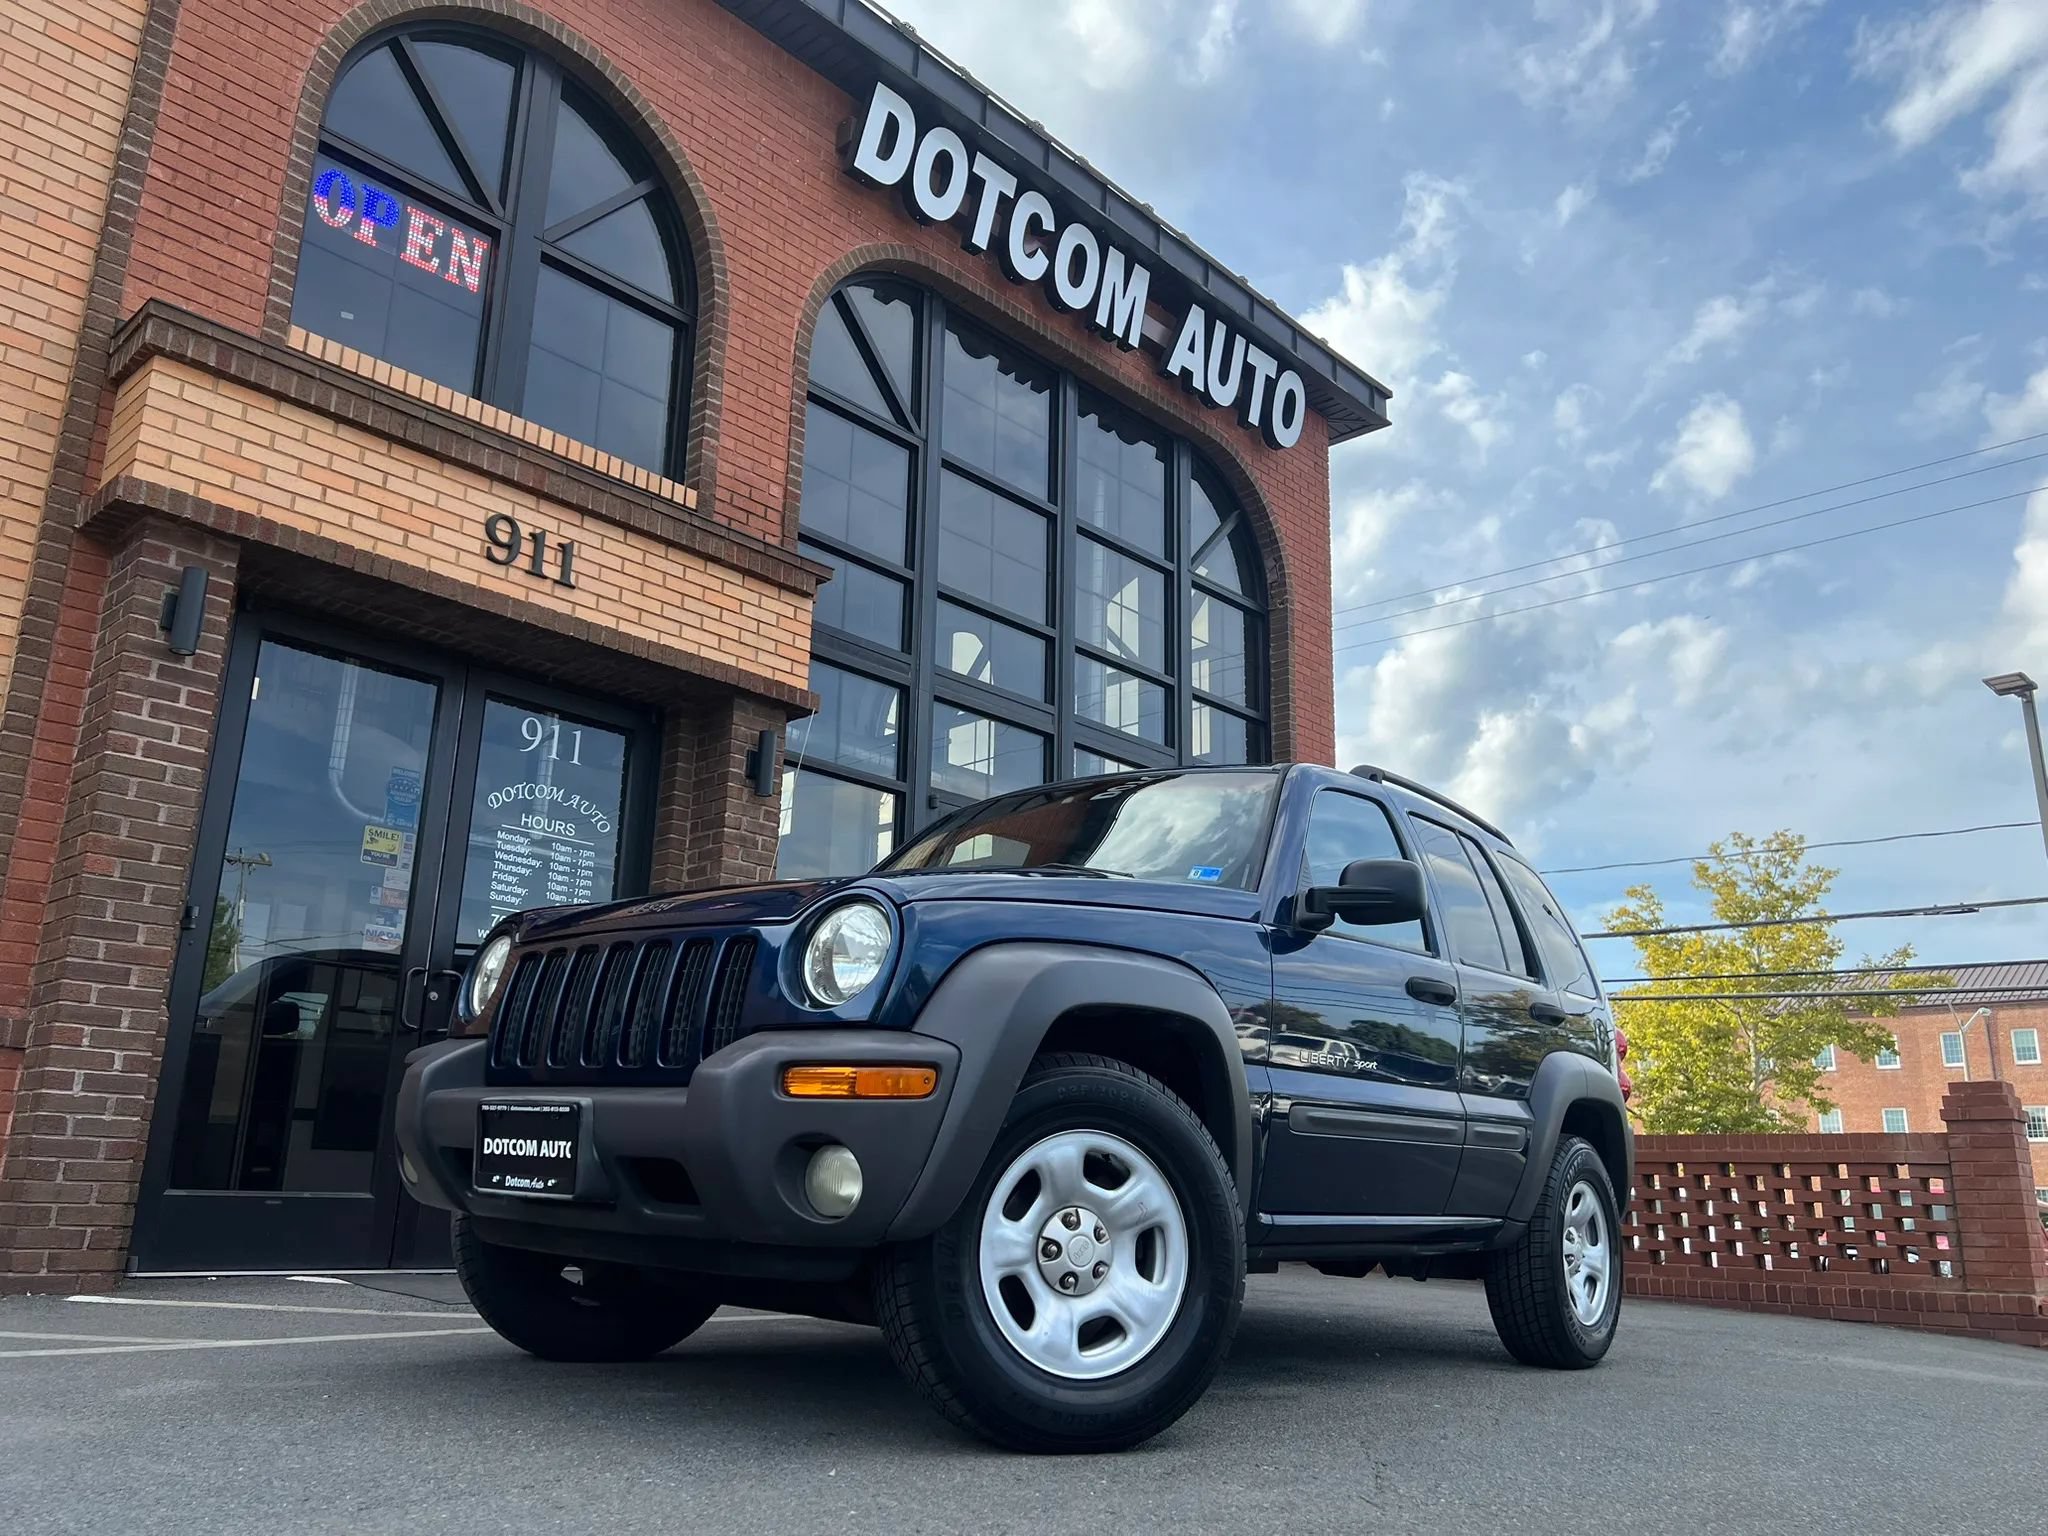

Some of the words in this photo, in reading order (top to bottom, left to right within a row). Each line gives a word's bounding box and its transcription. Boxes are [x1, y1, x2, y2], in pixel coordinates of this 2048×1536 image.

[314, 168, 488, 292] OPEN
[854, 81, 1150, 349] DOTCOM
[1166, 304, 1306, 449] AUTO
[485, 512, 576, 589] 911
[520, 716, 582, 766] 911
[488, 782, 563, 810] DOTCOM
[564, 794, 610, 834] AUTO
[368, 829, 400, 840] SMILE!
[521, 813, 576, 836] HOURS
[497, 831, 531, 844] Monday:
[552, 842, 572, 853] 10am
[579, 849, 595, 857] 7pm
[497, 841, 532, 855] Tuesday:
[551, 852, 571, 862] 10am
[578, 859, 594, 867] 7pm
[494, 861, 532, 875] Thursday:
[548, 872, 569, 882] 10am
[495, 851, 542, 867] Wednesday:
[550, 862, 570, 872] 10am
[577, 869, 593, 877] 7pm
[490, 881, 528, 896] Saturday:
[546, 892, 566, 902] 10am
[492, 871, 520, 884] Friday:
[547, 882, 567, 892] 10am
[489, 892, 522, 905] Sunday:
[1300, 1051, 1349, 1068] LIBERTY
[483, 1138, 537, 1157] DOTCOM
